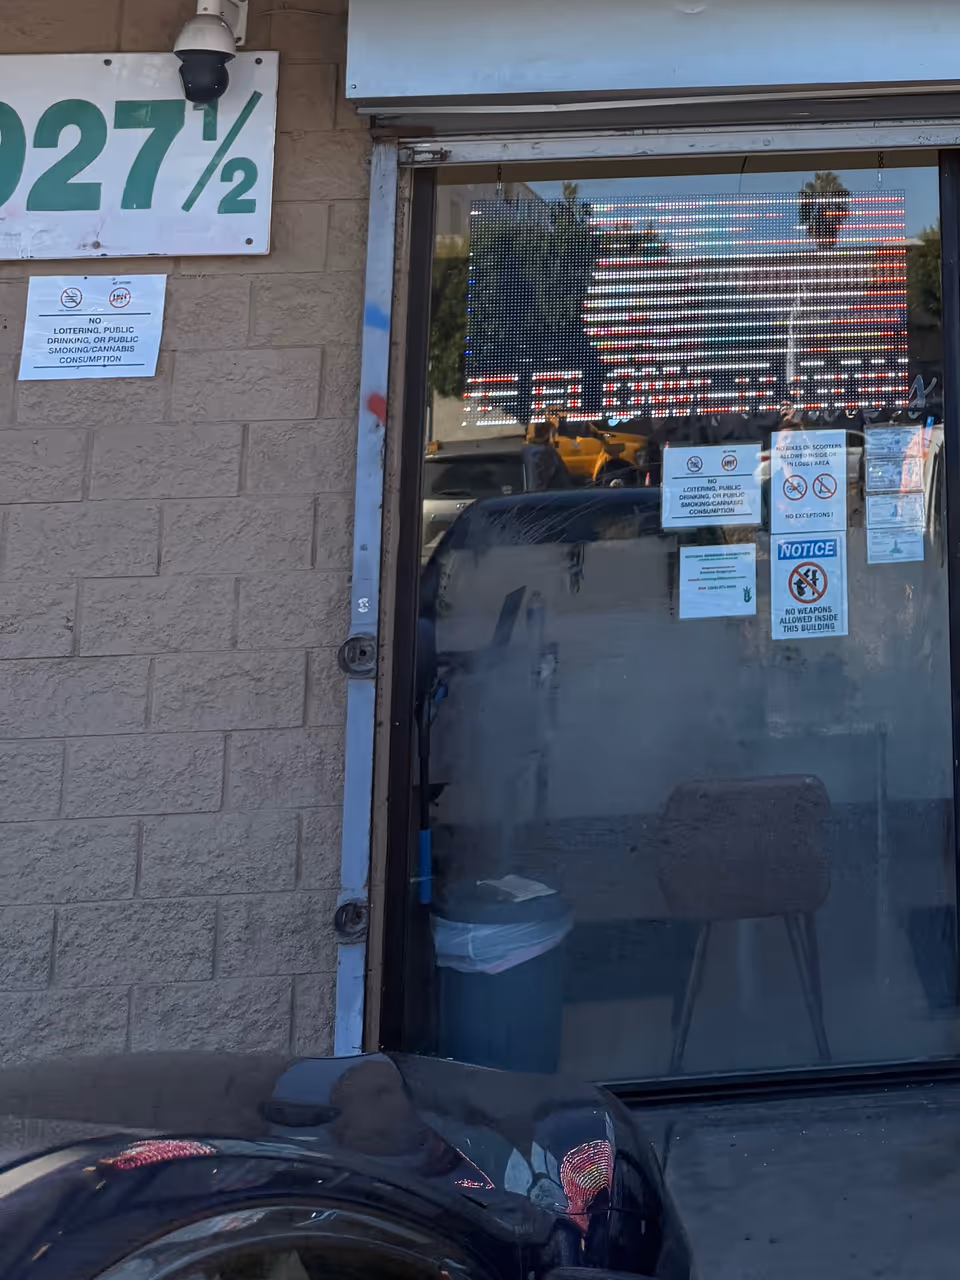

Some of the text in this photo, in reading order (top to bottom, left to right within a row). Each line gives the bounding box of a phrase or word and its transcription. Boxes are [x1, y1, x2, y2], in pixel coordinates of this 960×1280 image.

[88, 317, 102, 325] NO
[53, 326, 135, 335] LOITERING, PUBLIC
[47, 335, 139, 345] DRINKING, OR PUBLIC
[48, 345, 135, 354] SMOKING/CANNABIS
[59, 355, 122, 364] CONSUMPTION
[780, 541, 835, 558] NOTICE
[785, 605, 833, 616] NO WEAPONS
[780, 613, 839, 625] ALLOWED INSIDE
[783, 624, 799, 633] THIS
[800, 622, 835, 632] BUILDING
